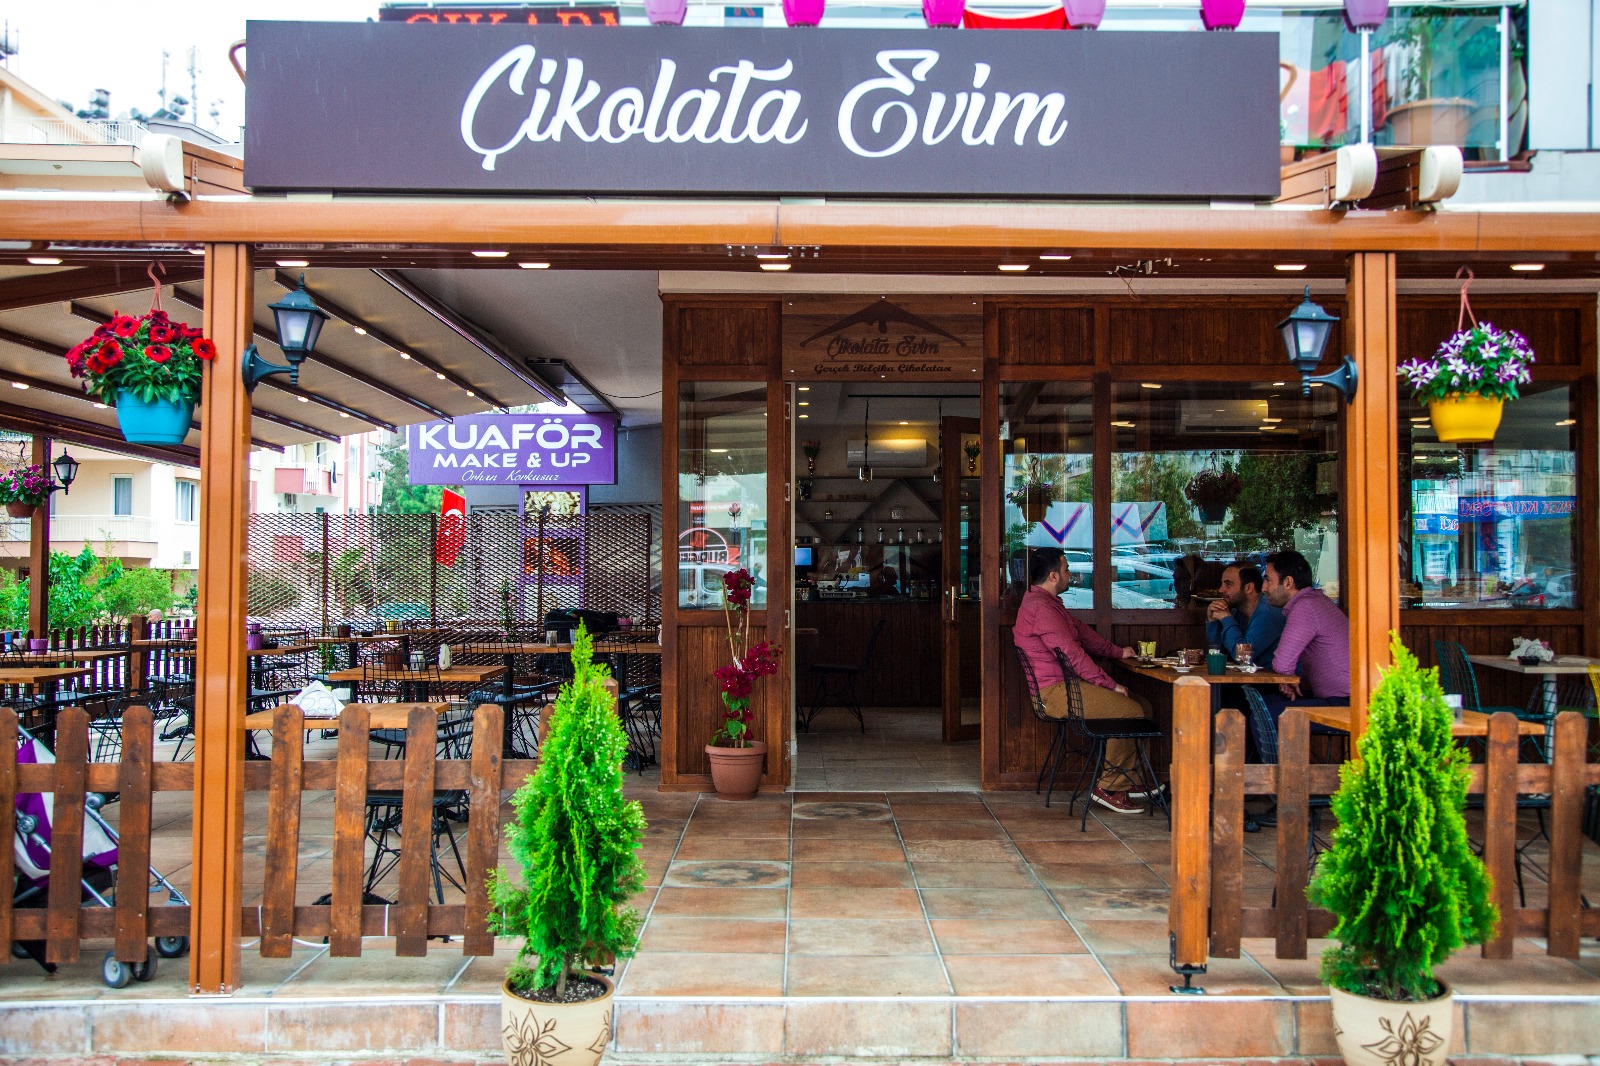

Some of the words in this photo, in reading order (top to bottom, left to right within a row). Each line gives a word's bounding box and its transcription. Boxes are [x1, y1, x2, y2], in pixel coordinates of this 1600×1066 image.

[460, 44, 808, 171] Çikolata
[837, 49, 1068, 158] Evim
[827, 335, 890, 360] Çikolata
[896, 335, 939, 357] Evim
[814, 364, 849, 375] Gerçek
[853, 364, 895, 374] Belçika
[419, 418, 603, 450] KUAFÖR
[433, 453, 517, 468] MAKE
[526, 452, 542, 468] &
[551, 452, 591, 467] UP
[461, 469, 498, 482] Orhan
[505, 469, 561, 482] Korkusuz
